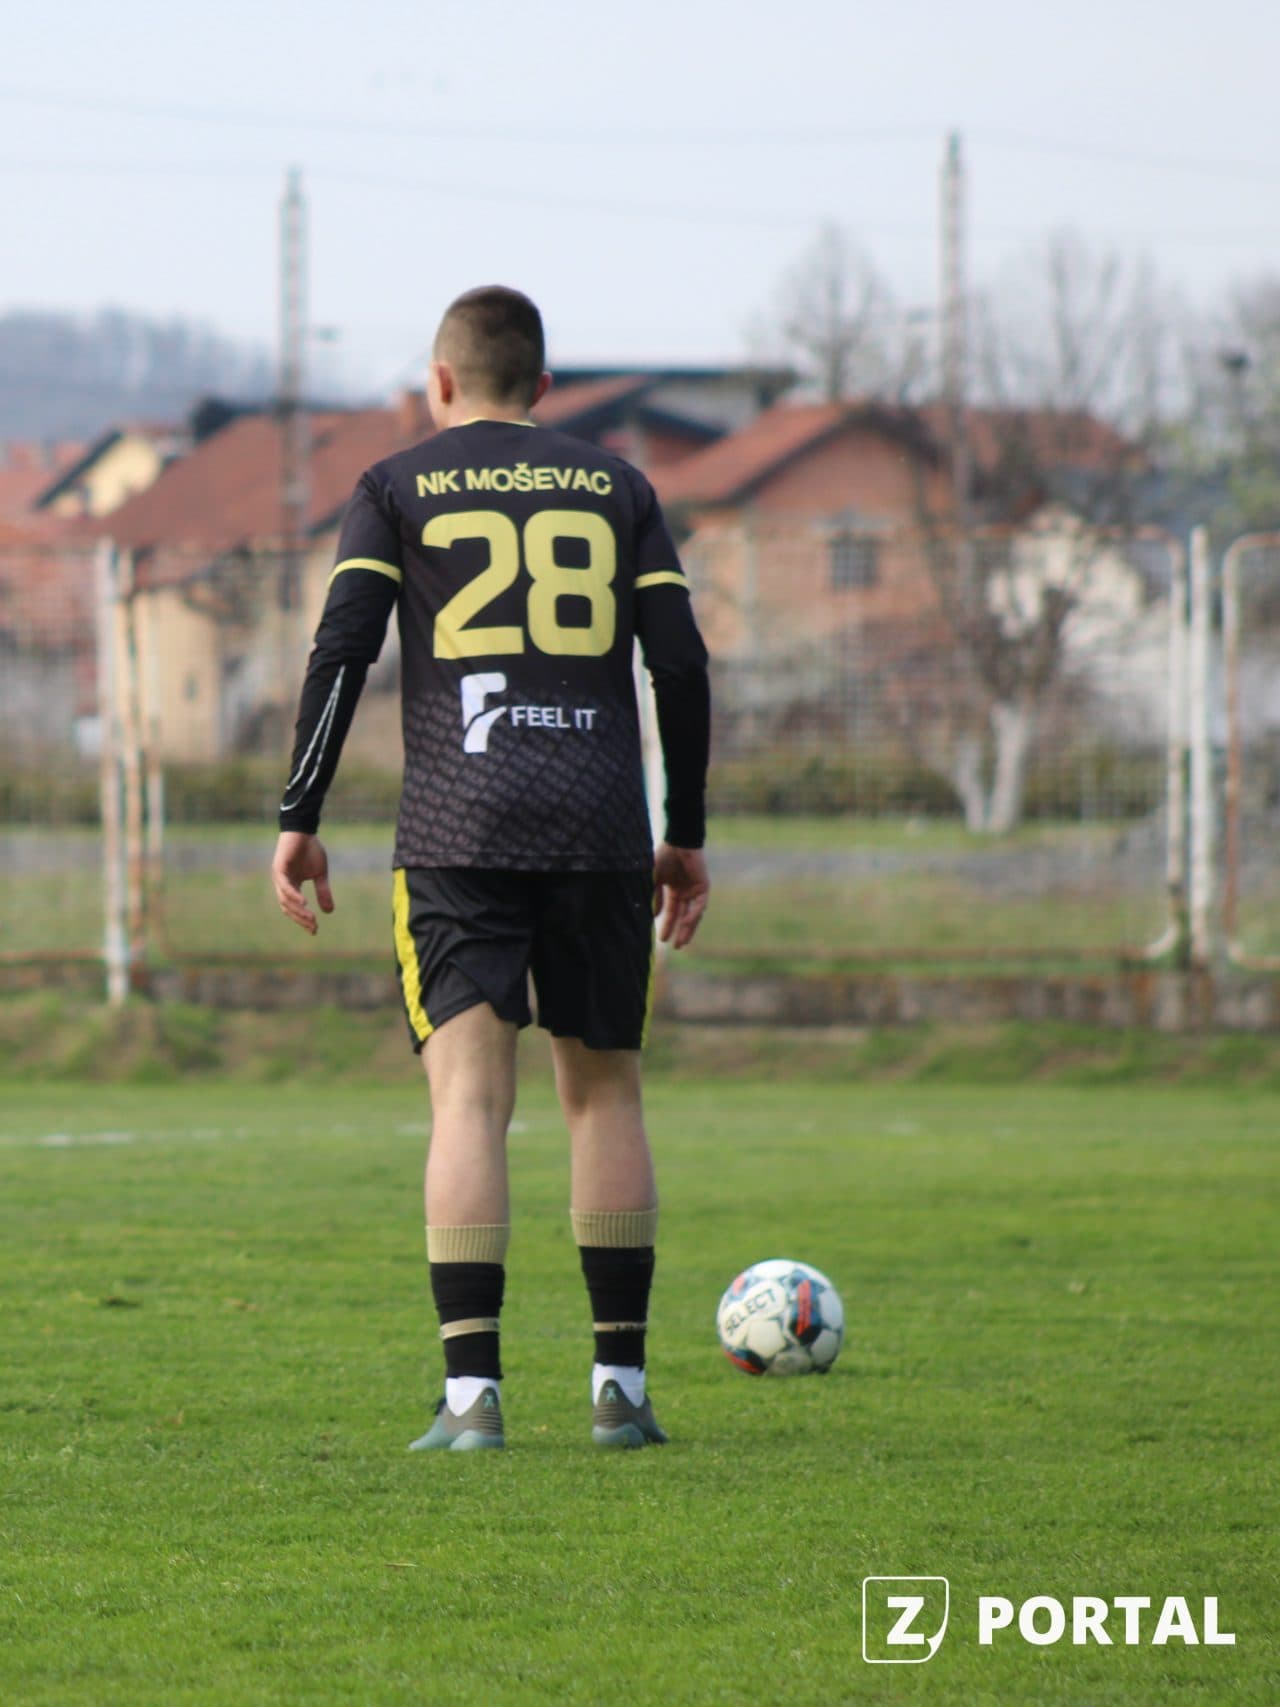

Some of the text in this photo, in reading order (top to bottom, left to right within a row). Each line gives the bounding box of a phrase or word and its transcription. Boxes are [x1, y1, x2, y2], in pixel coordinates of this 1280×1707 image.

[416, 462, 613, 497] NK MOŠEVAC
[421, 509, 617, 660] 28
[511, 705, 597, 730] FEEL IT
